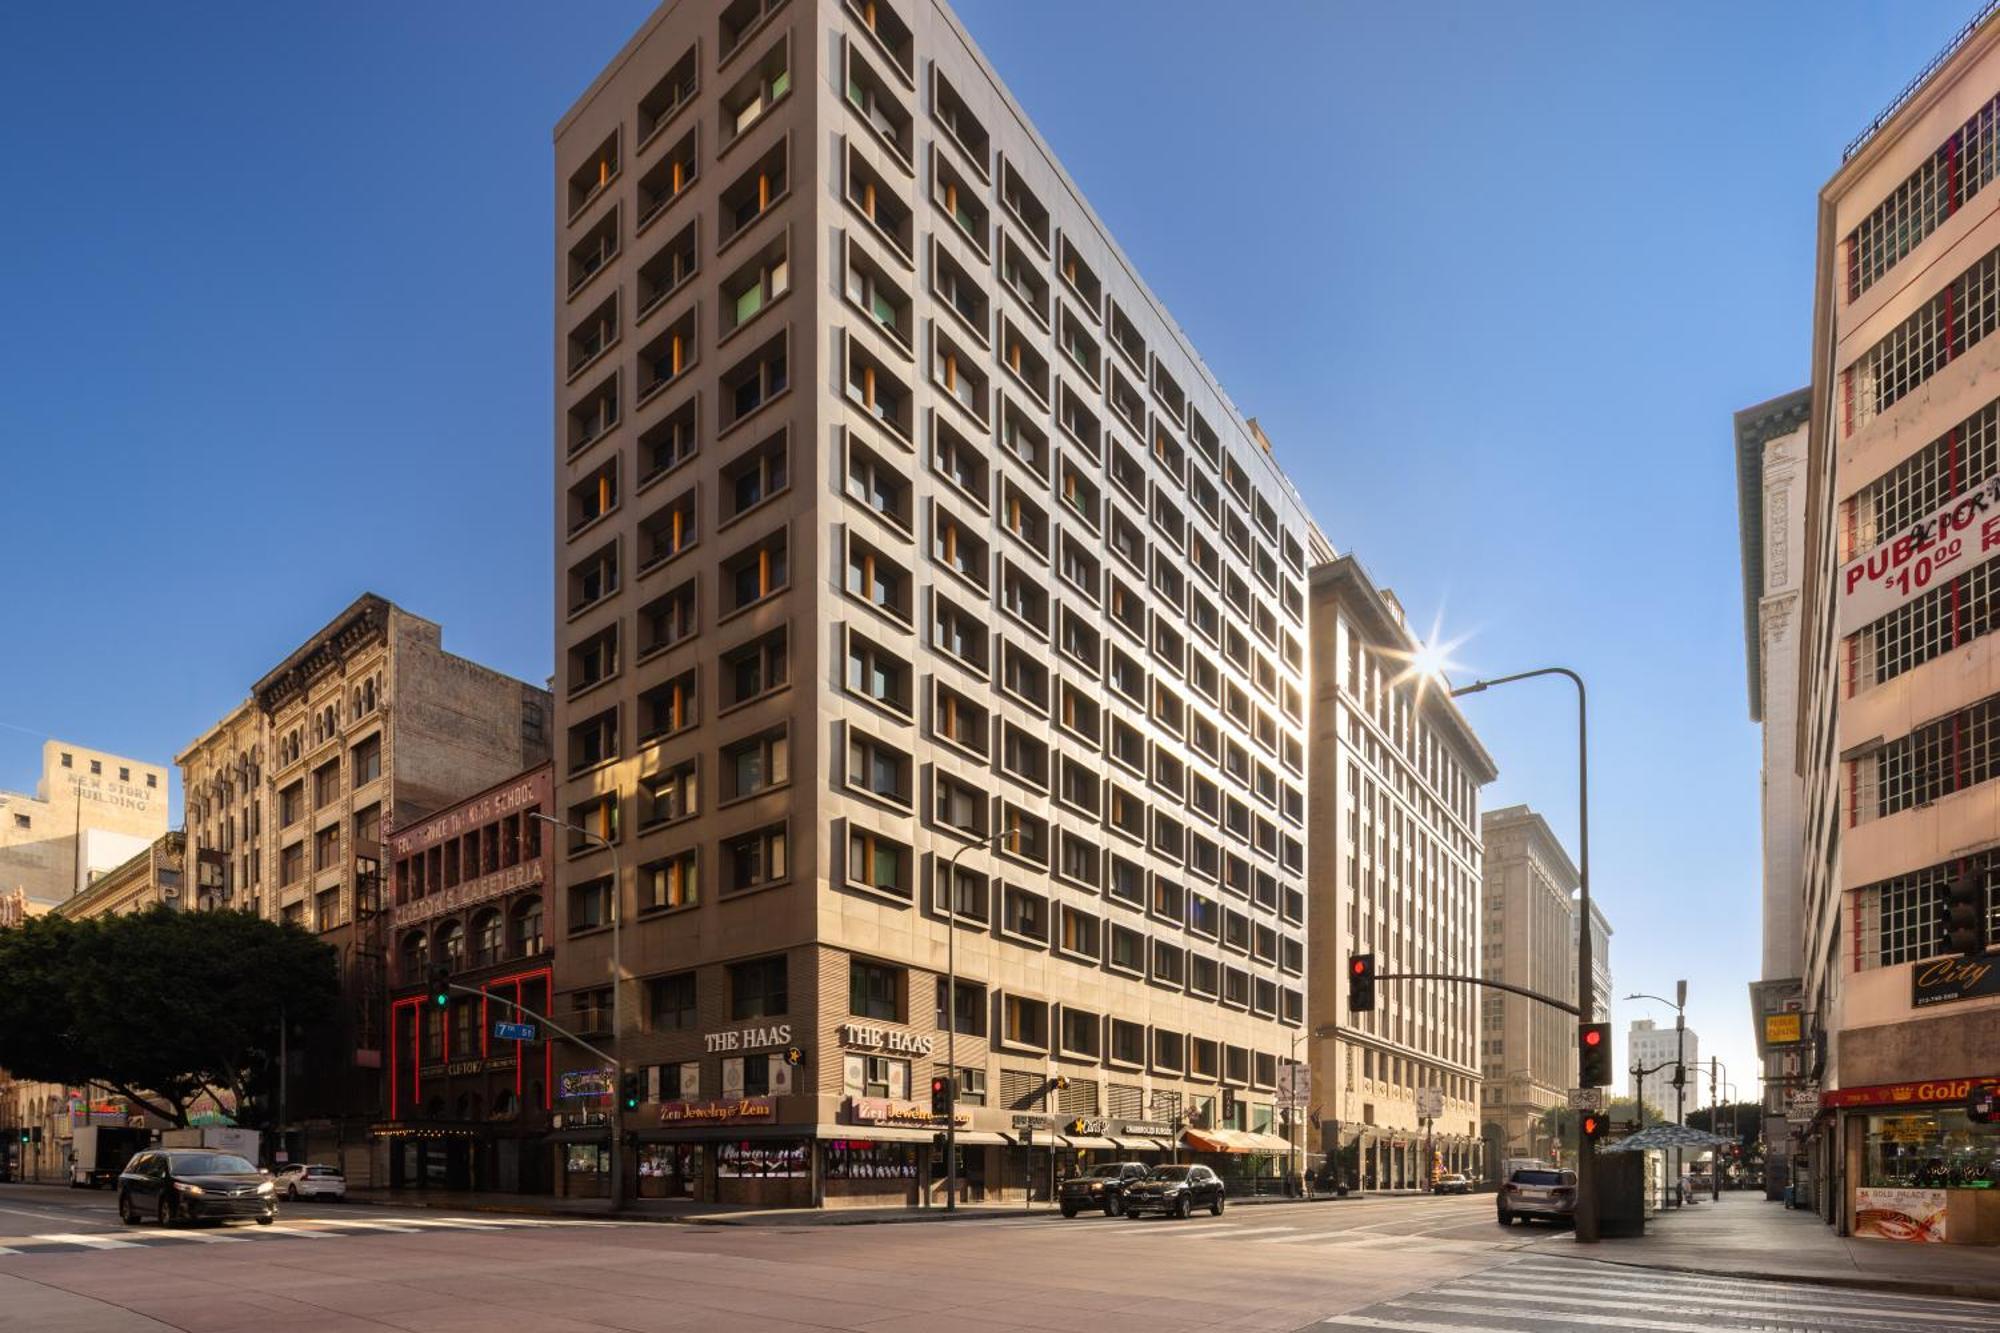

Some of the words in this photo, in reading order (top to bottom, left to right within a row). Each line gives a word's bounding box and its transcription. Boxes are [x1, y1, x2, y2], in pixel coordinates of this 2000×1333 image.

[68, 773, 101, 789] NEW
[108, 782, 150, 801] STORY
[73, 786, 146, 811] BUILDING
[495, 782, 534, 814] SCHOOL
[461, 862, 543, 904] CAFETERIA
[1918, 959, 1992, 990] City
[704, 1031, 739, 1052] THE
[743, 1024, 792, 1049] HAAS
[845, 1023, 884, 1047] THE
[888, 1030, 933, 1054] HAAS
[1918, 1080, 1971, 1101] Gold
[683, 1102, 728, 1121] Jewelry
[1083, 1119, 1102, 1134] Carl's
